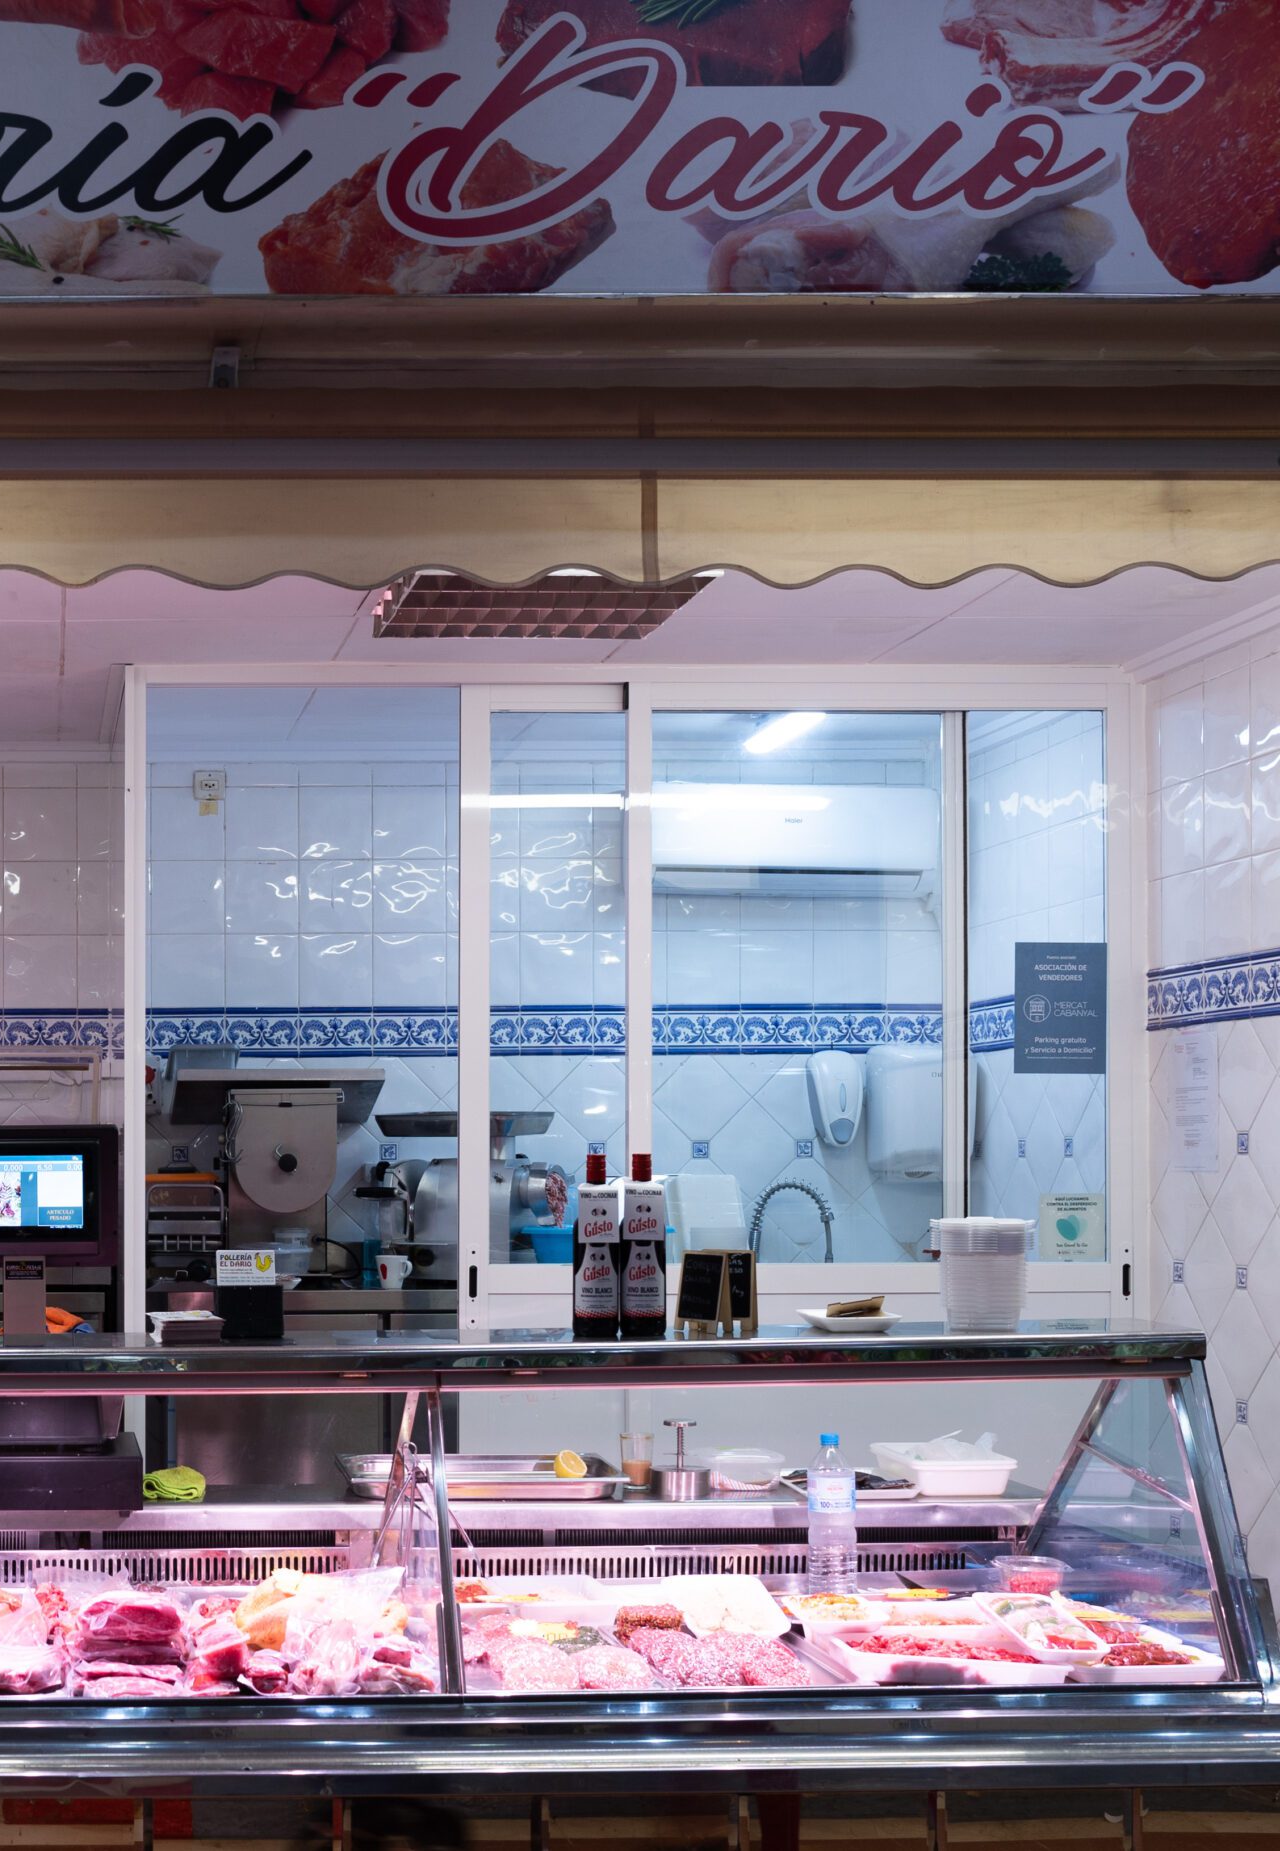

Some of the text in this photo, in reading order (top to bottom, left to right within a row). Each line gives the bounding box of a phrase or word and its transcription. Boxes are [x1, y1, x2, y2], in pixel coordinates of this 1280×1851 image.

[784, 816, 803, 824] Haier
[1034, 963, 1077, 971] ASOCIACIÓN
[1054, 1001, 1088, 1009] MERCAT
[1034, 1036, 1059, 1044] Parking
